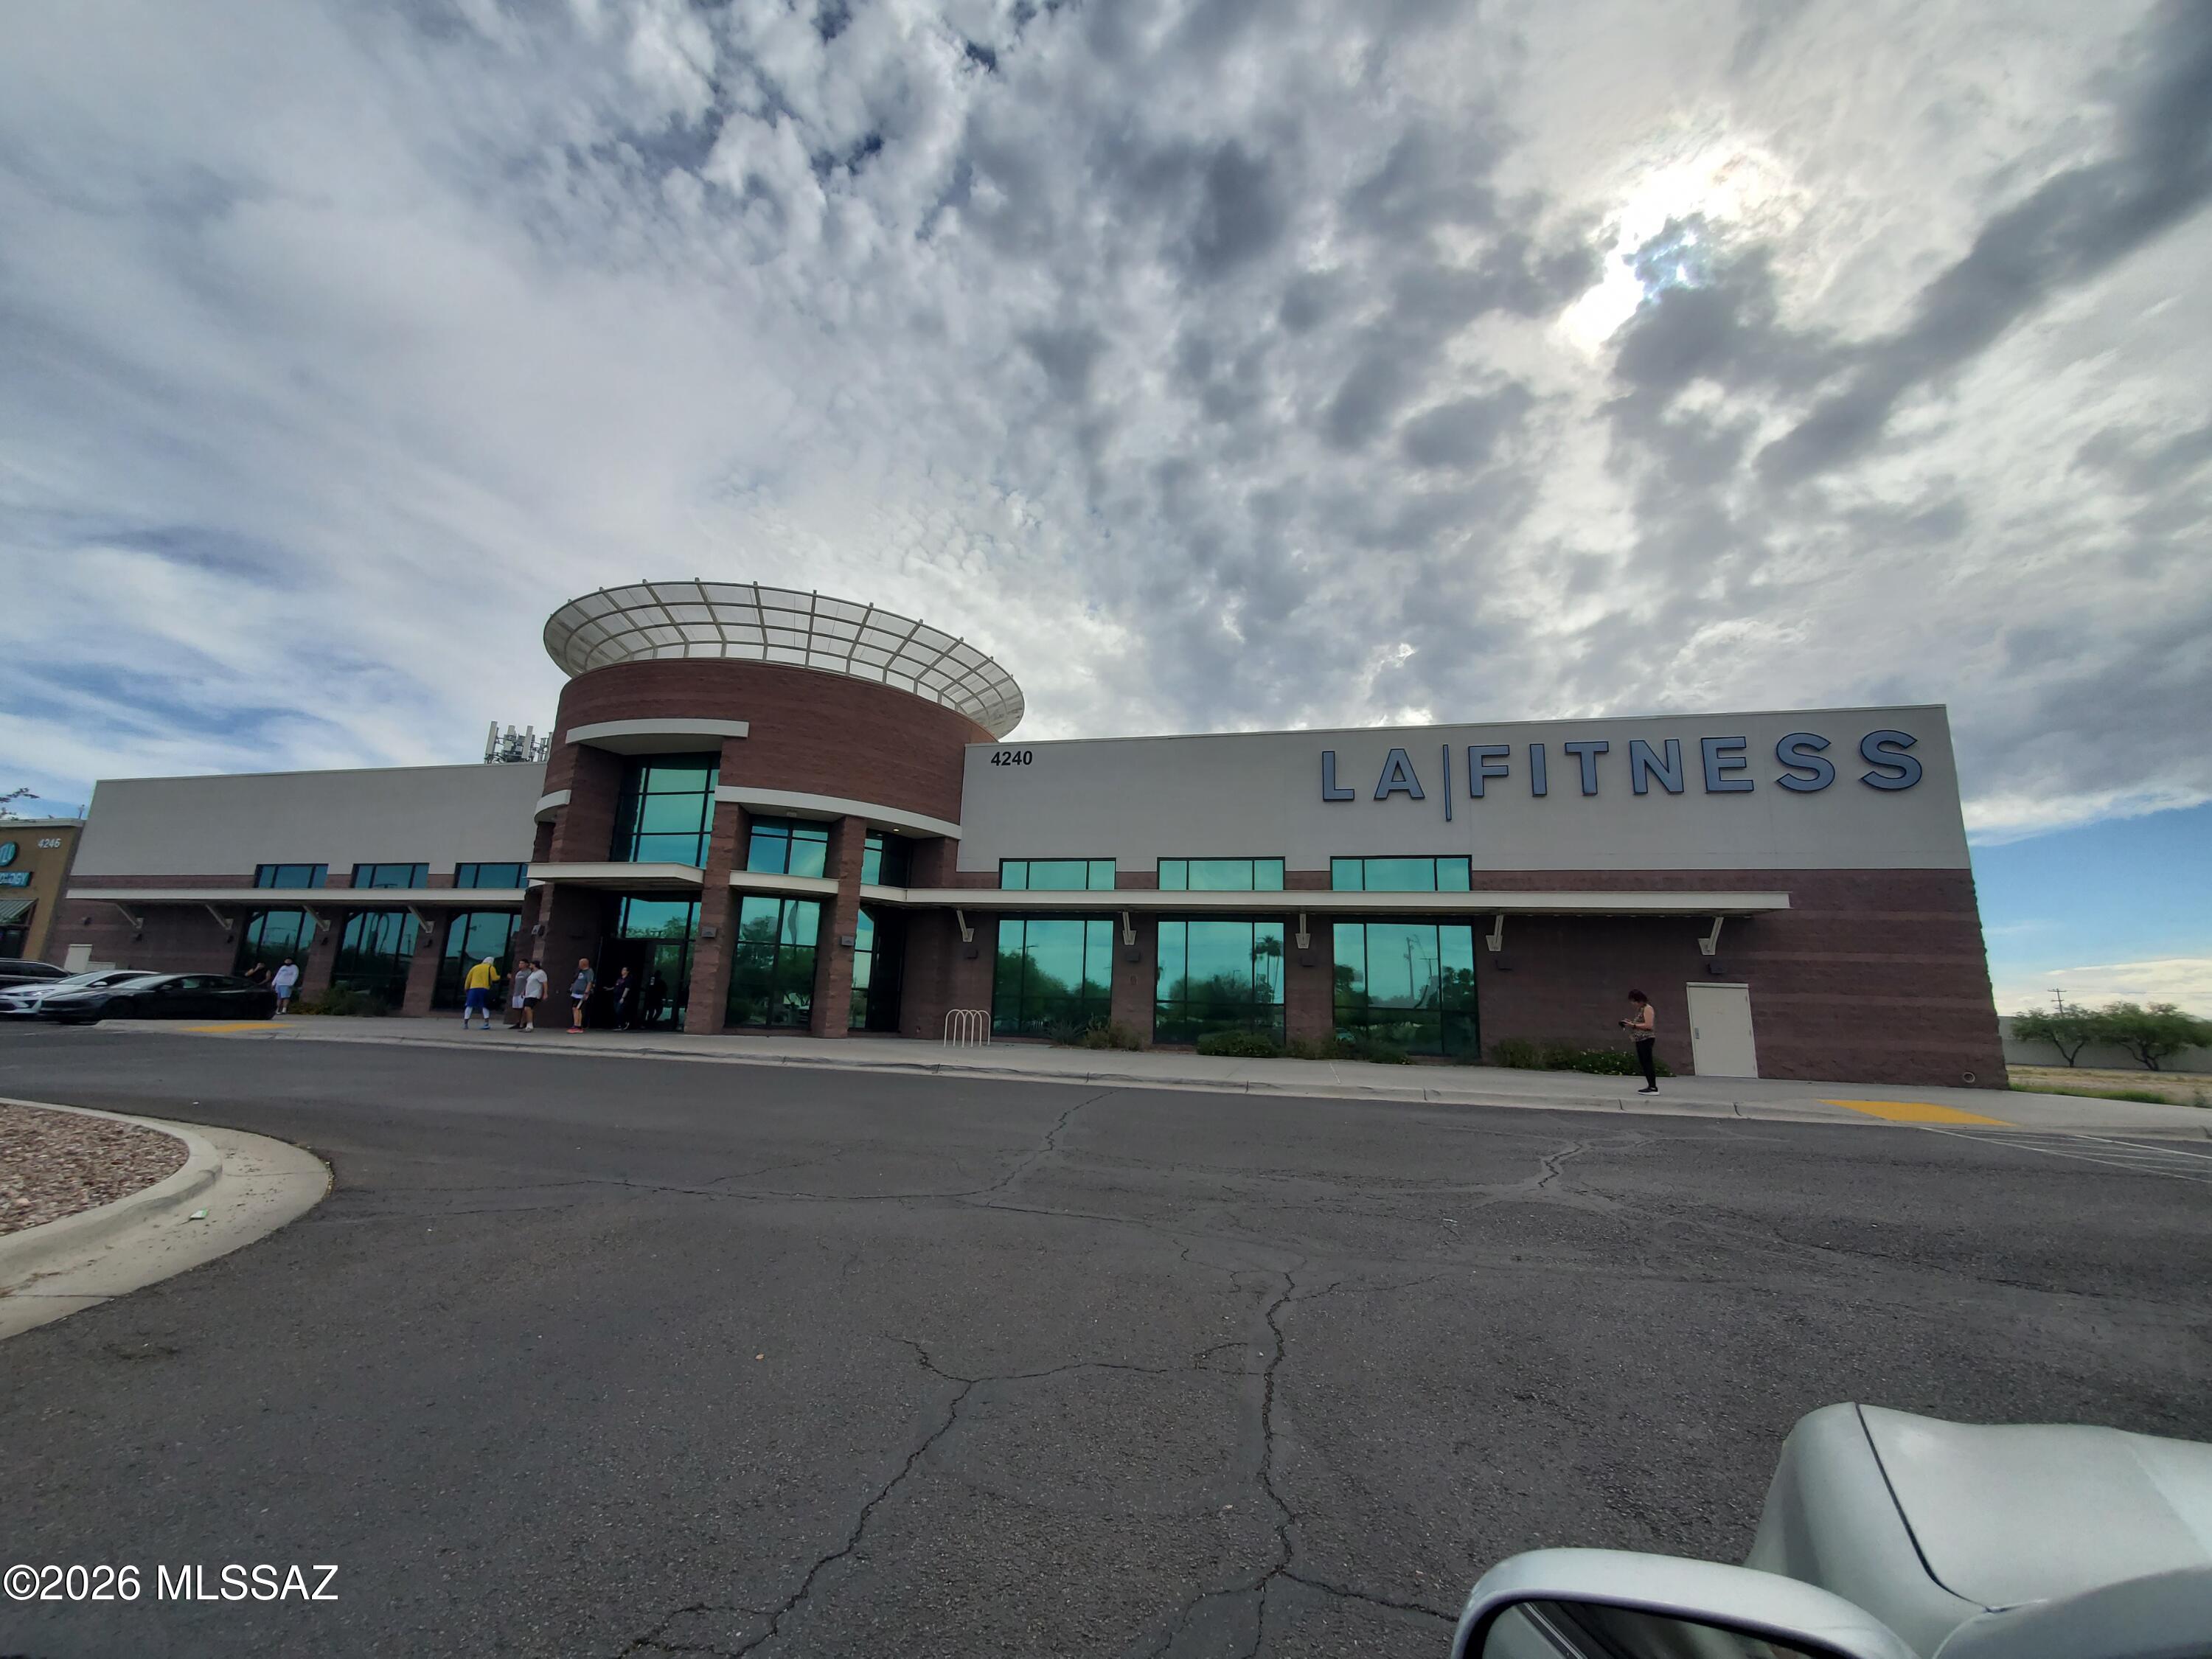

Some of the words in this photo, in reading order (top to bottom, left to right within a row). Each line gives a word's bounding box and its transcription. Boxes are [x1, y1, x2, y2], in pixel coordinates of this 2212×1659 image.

[991, 751, 1033, 766] 4240
[1321, 748, 1426, 801] LA
[1468, 729, 1923, 799] FITNESS
[38, 838, 61, 849] 4246
